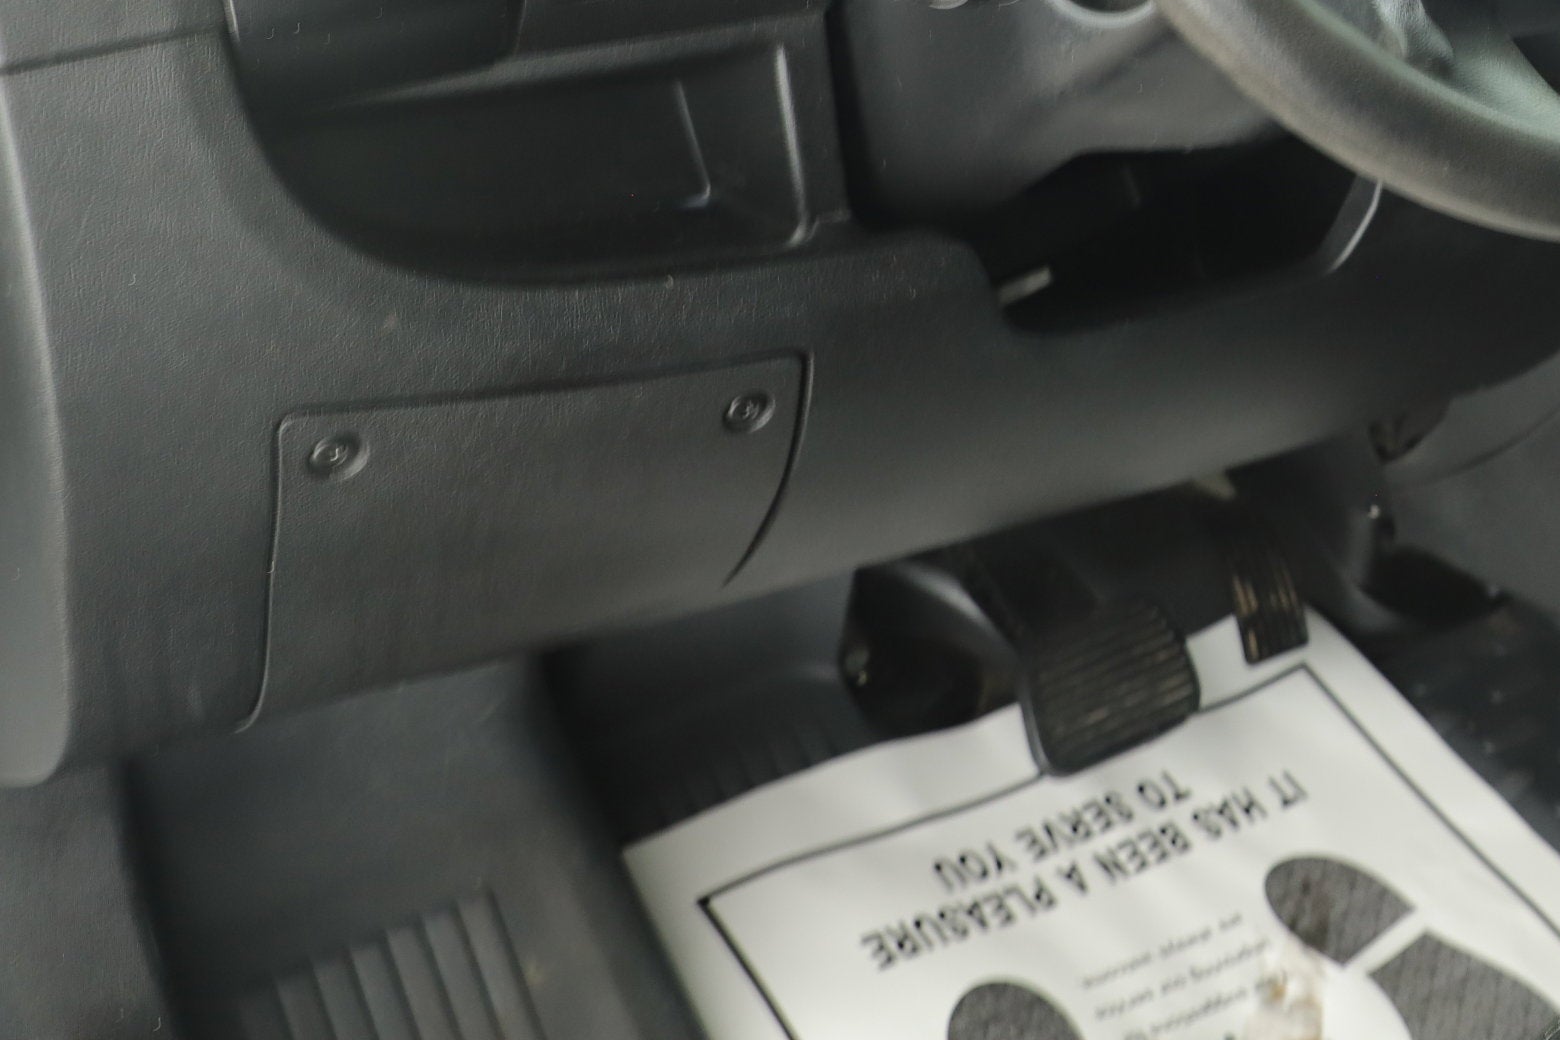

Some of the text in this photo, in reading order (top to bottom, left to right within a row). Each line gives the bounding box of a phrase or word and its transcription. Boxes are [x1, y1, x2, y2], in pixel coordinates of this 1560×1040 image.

[860, 770, 1308, 970] IT HAS BEEN A PLEASURE
[932, 769, 1192, 893] TO SERVE YOU
